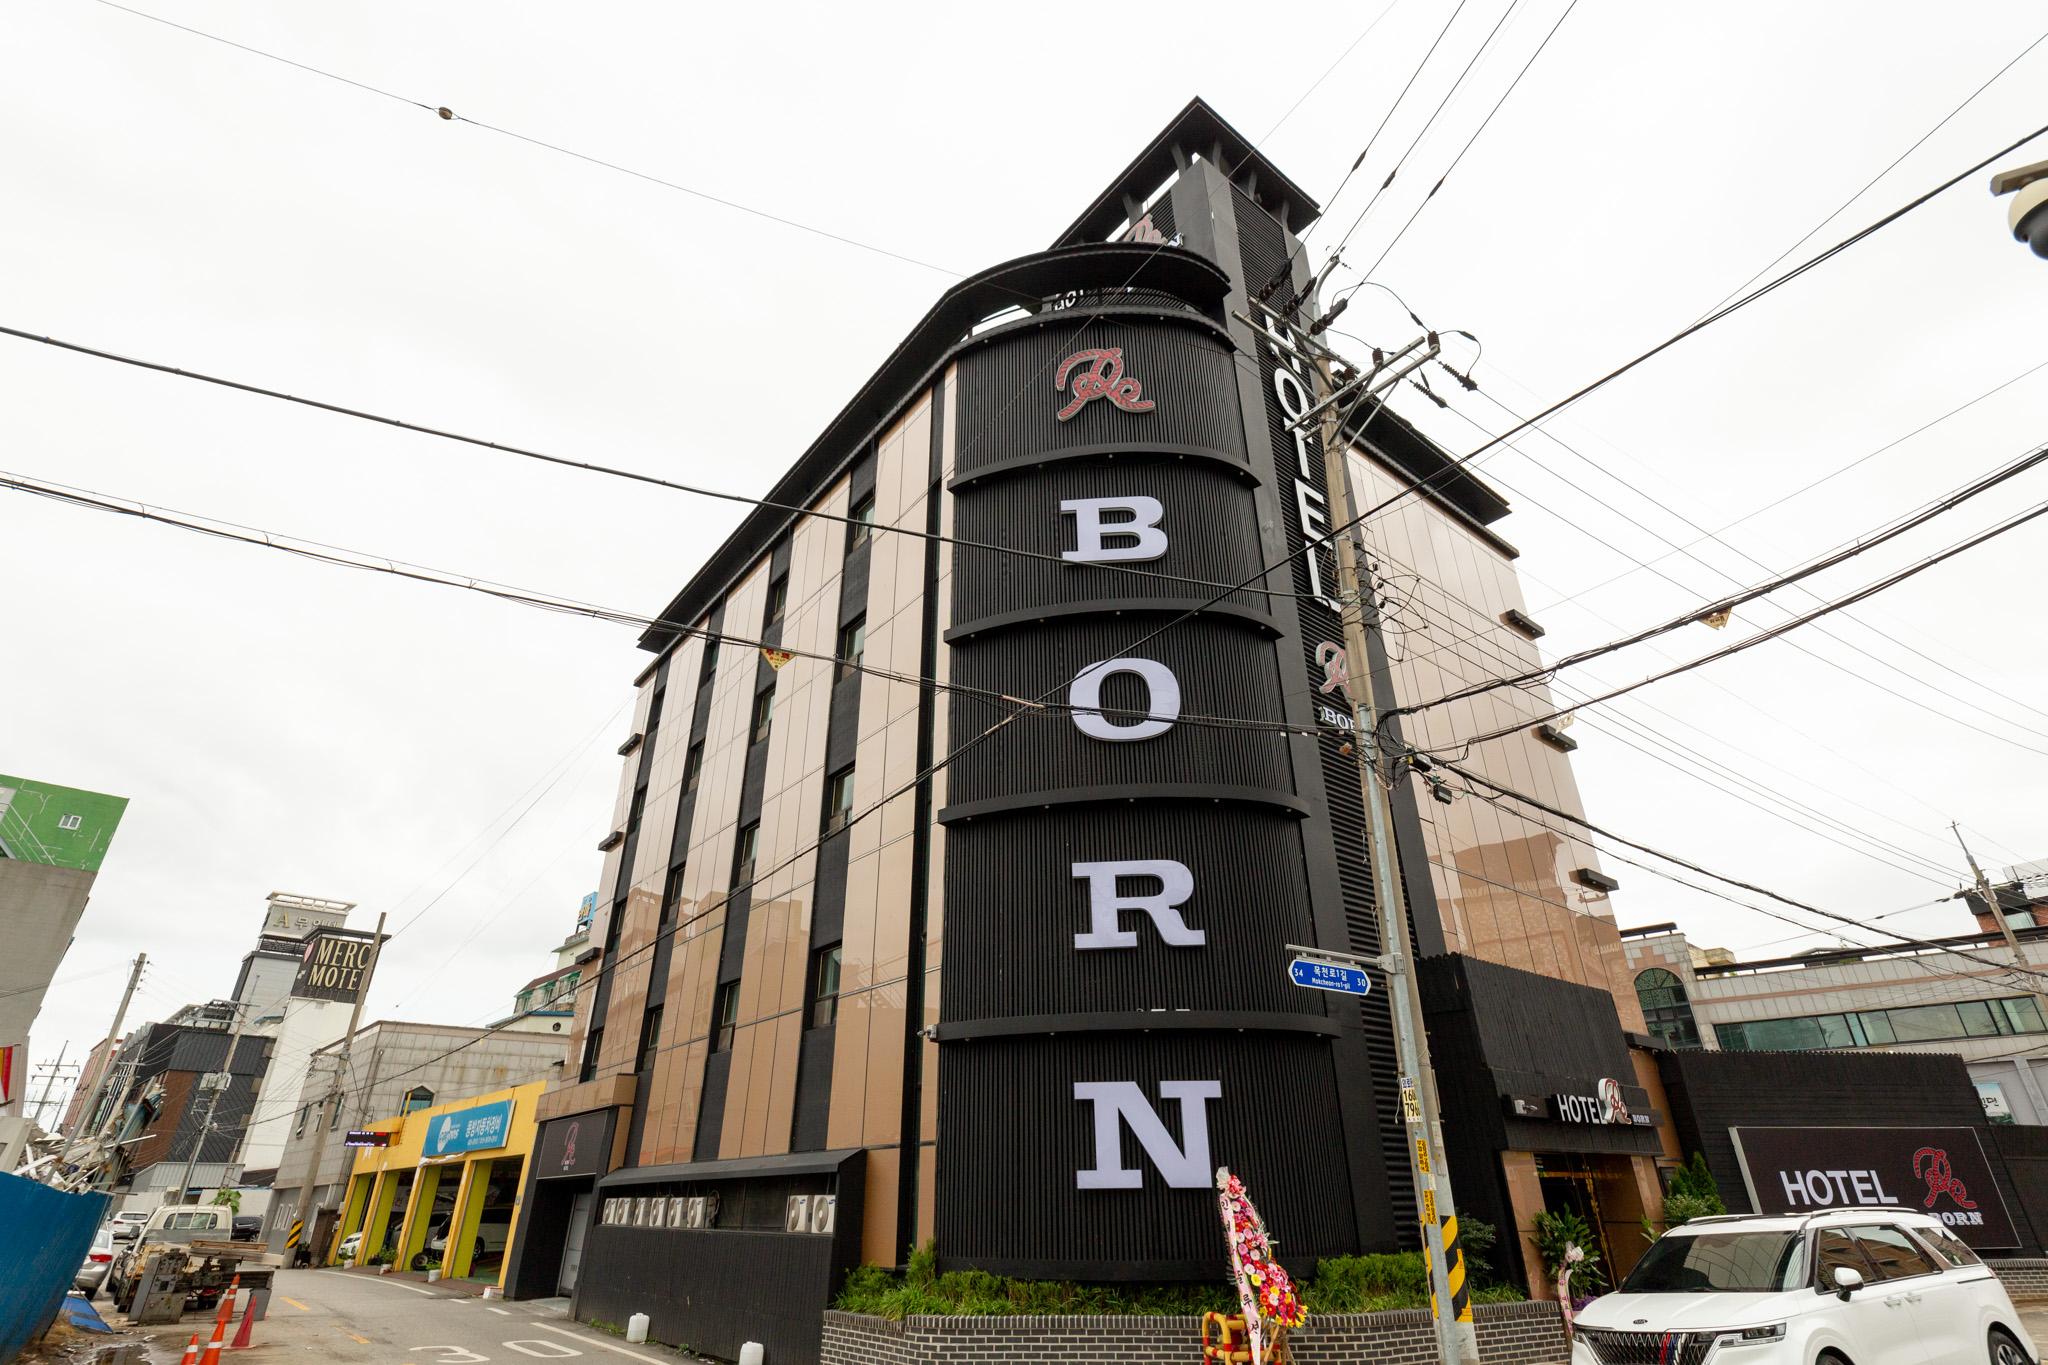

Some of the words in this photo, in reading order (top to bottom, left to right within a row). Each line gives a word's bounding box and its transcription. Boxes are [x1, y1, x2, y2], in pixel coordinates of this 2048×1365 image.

[1294, 968, 1304, 977] 34
[1313, 965, 1348, 981] 목천로1길
[1356, 977, 1366, 987] 30
[1556, 1093, 1608, 1125] HOTEL
[1779, 1169, 1899, 1206] HOTEL
